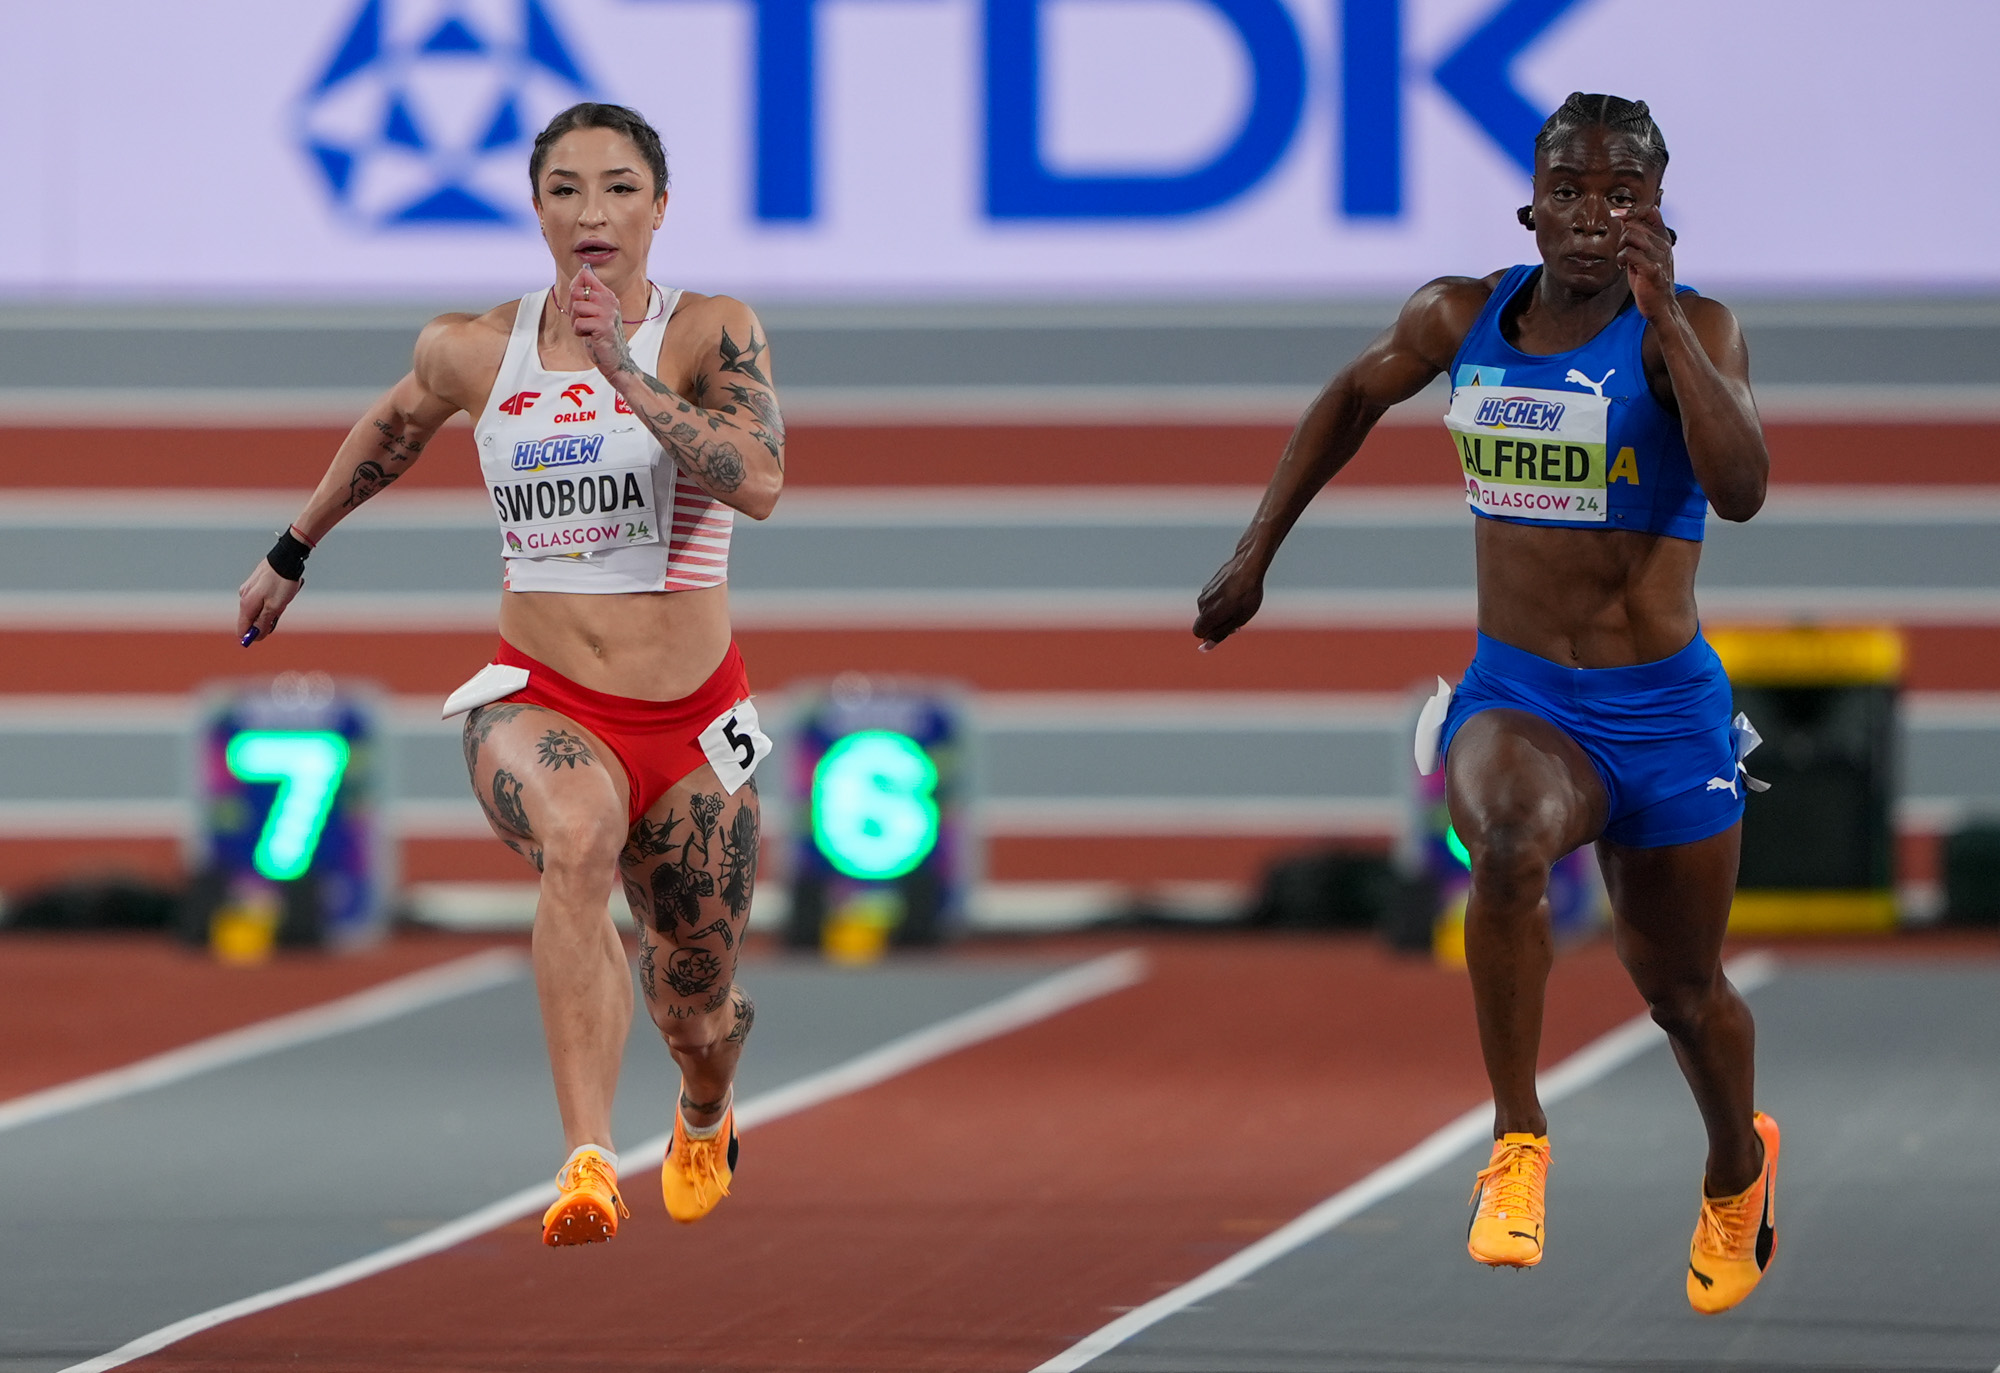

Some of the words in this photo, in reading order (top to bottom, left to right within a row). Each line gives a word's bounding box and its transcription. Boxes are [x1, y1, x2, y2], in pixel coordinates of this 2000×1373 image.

[622, 0, 1600, 224] TDK
[498, 391, 542, 416] 4F
[553, 410, 597, 424] ORLEN
[1474, 397, 1566, 431] HI-CHEW
[511, 434, 604, 471] HI-CHEW
[1462, 435, 1590, 482] ALFRED
[493, 472, 646, 523] SWOBODA
[1482, 490, 1571, 511] GLASGOW
[1575, 496, 1599, 512] 24
[527, 523, 620, 549] GLASGOW
[625, 521, 649, 538] 24
[722, 715, 756, 770] 5
[226, 730, 350, 881] 7
[811, 730, 940, 881] 6
